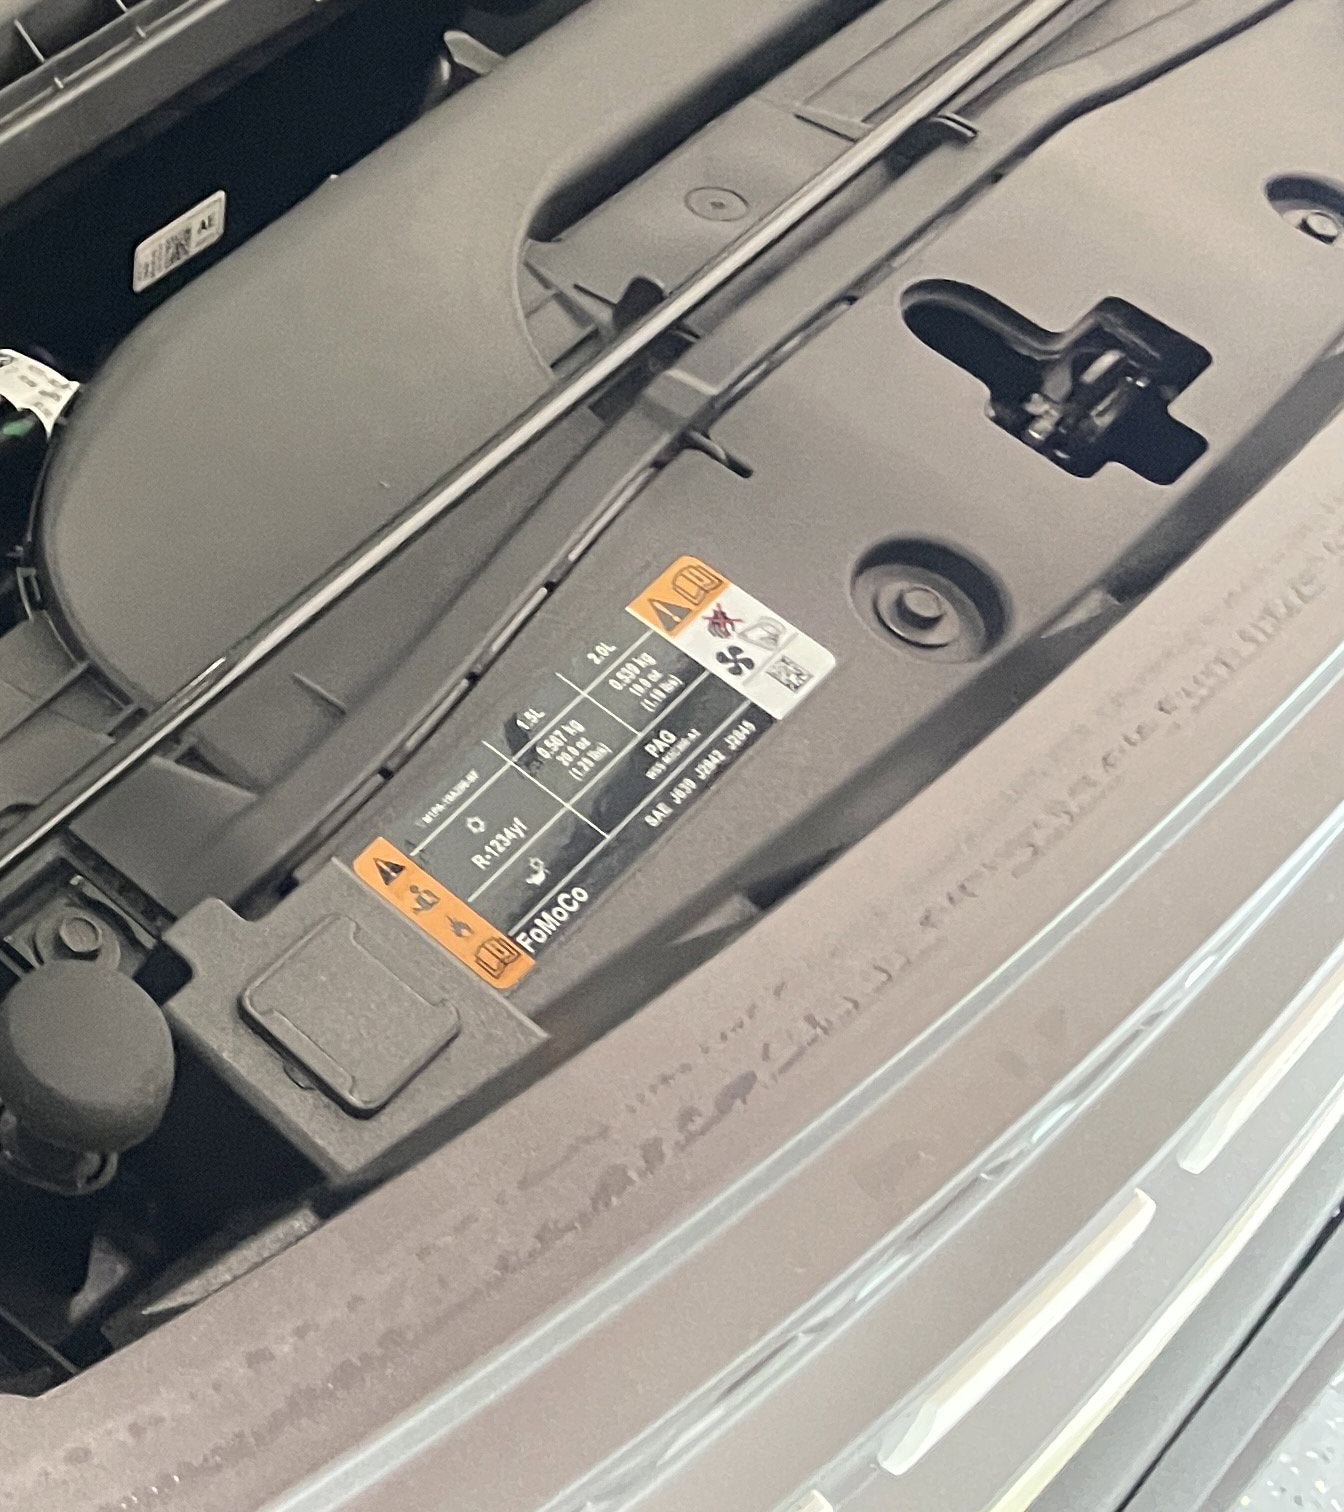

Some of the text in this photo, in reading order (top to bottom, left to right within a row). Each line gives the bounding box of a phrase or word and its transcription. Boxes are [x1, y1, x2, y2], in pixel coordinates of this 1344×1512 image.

[587, 642, 617, 665] 2.0L
[516, 708, 546, 731] 1.5L
[644, 729, 677, 758] PAG
[516, 887, 589, 953] FoMoCo
